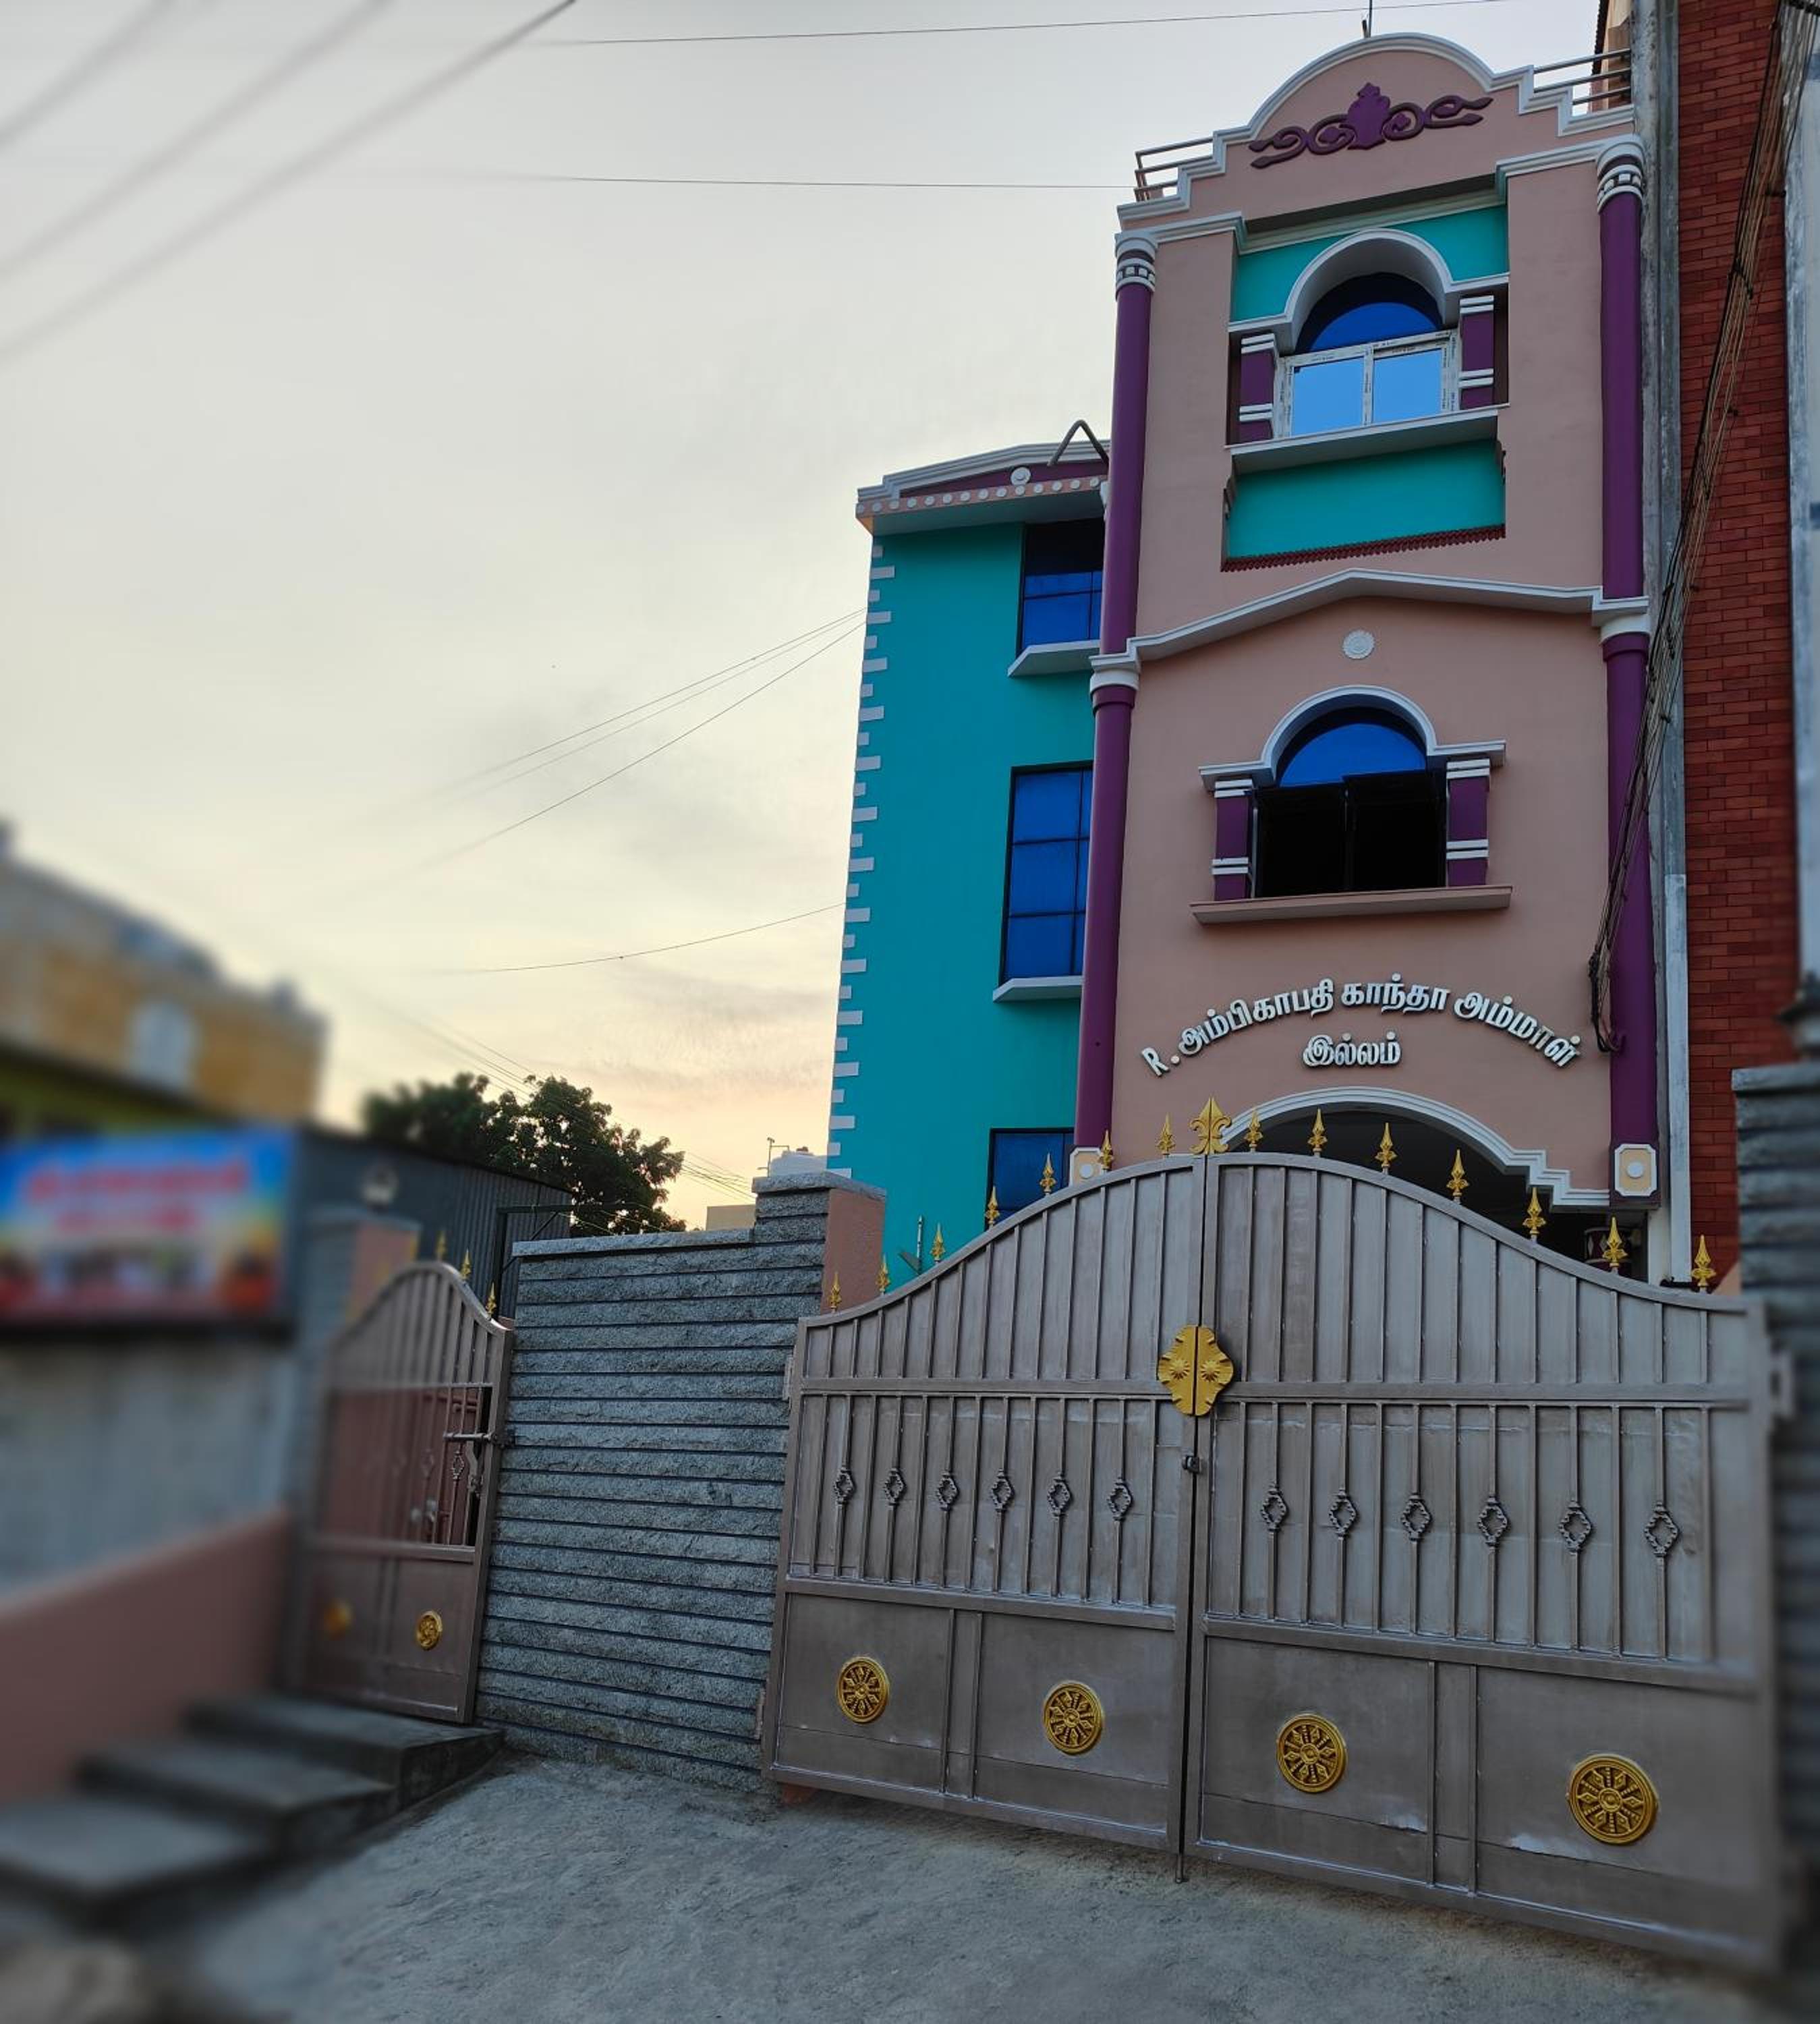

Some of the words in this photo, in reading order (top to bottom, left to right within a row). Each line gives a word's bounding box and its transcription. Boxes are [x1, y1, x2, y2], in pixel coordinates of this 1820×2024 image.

[1303, 1031, 1401, 1067] இல்லம்
[1341, 973, 1450, 1013] காந்தா
[1454, 992, 1581, 1067] அம்மாள்
